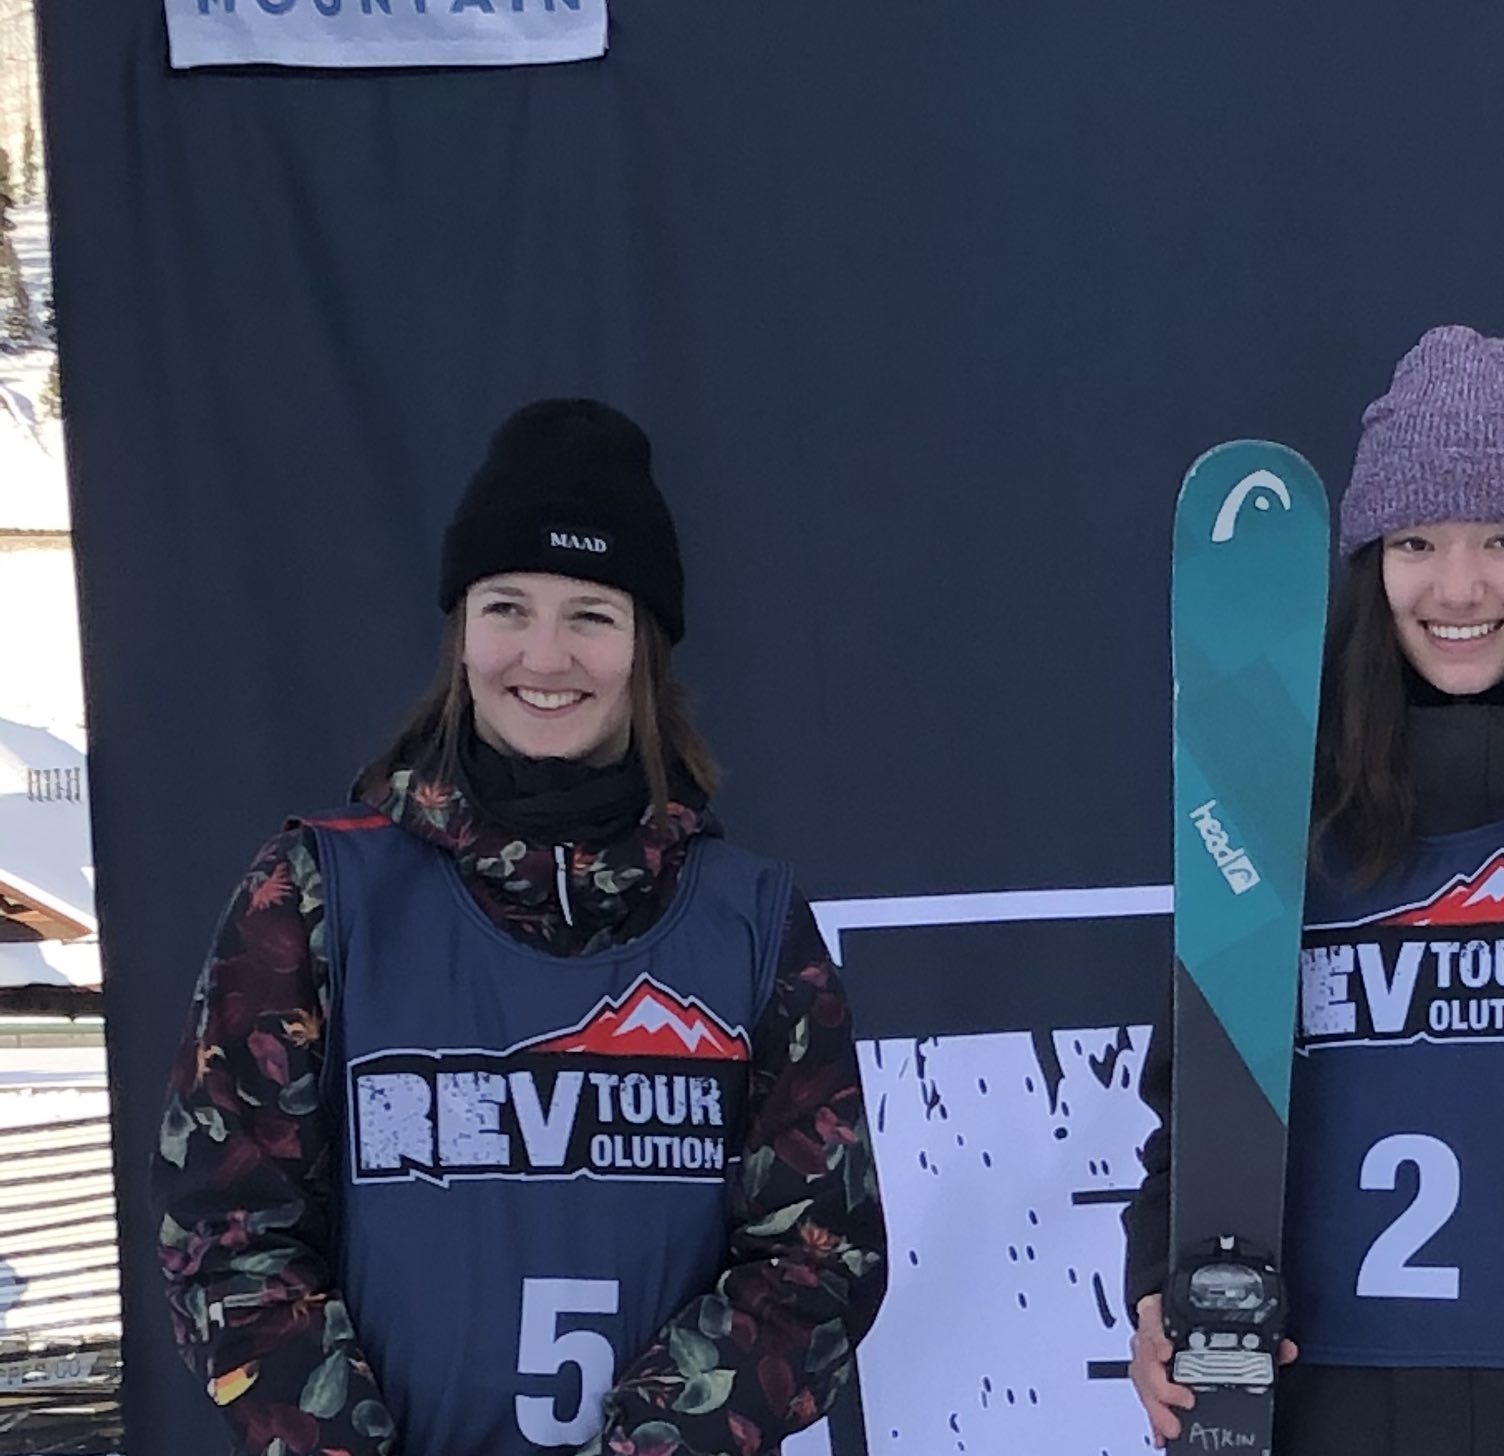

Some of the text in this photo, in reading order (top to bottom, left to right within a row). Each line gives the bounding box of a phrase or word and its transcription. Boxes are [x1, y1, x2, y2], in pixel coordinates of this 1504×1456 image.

[549, 531, 608, 553] MAAD
[1189, 799, 1245, 868] head
[1301, 941, 1427, 1036] EV
[356, 1070, 724, 1170] REV TOUR
[590, 1134, 724, 1170] OLUTION
[1356, 1132, 1461, 1300] 2
[513, 1276, 620, 1448] 5
[1189, 1421, 1256, 1451] ATKIN
